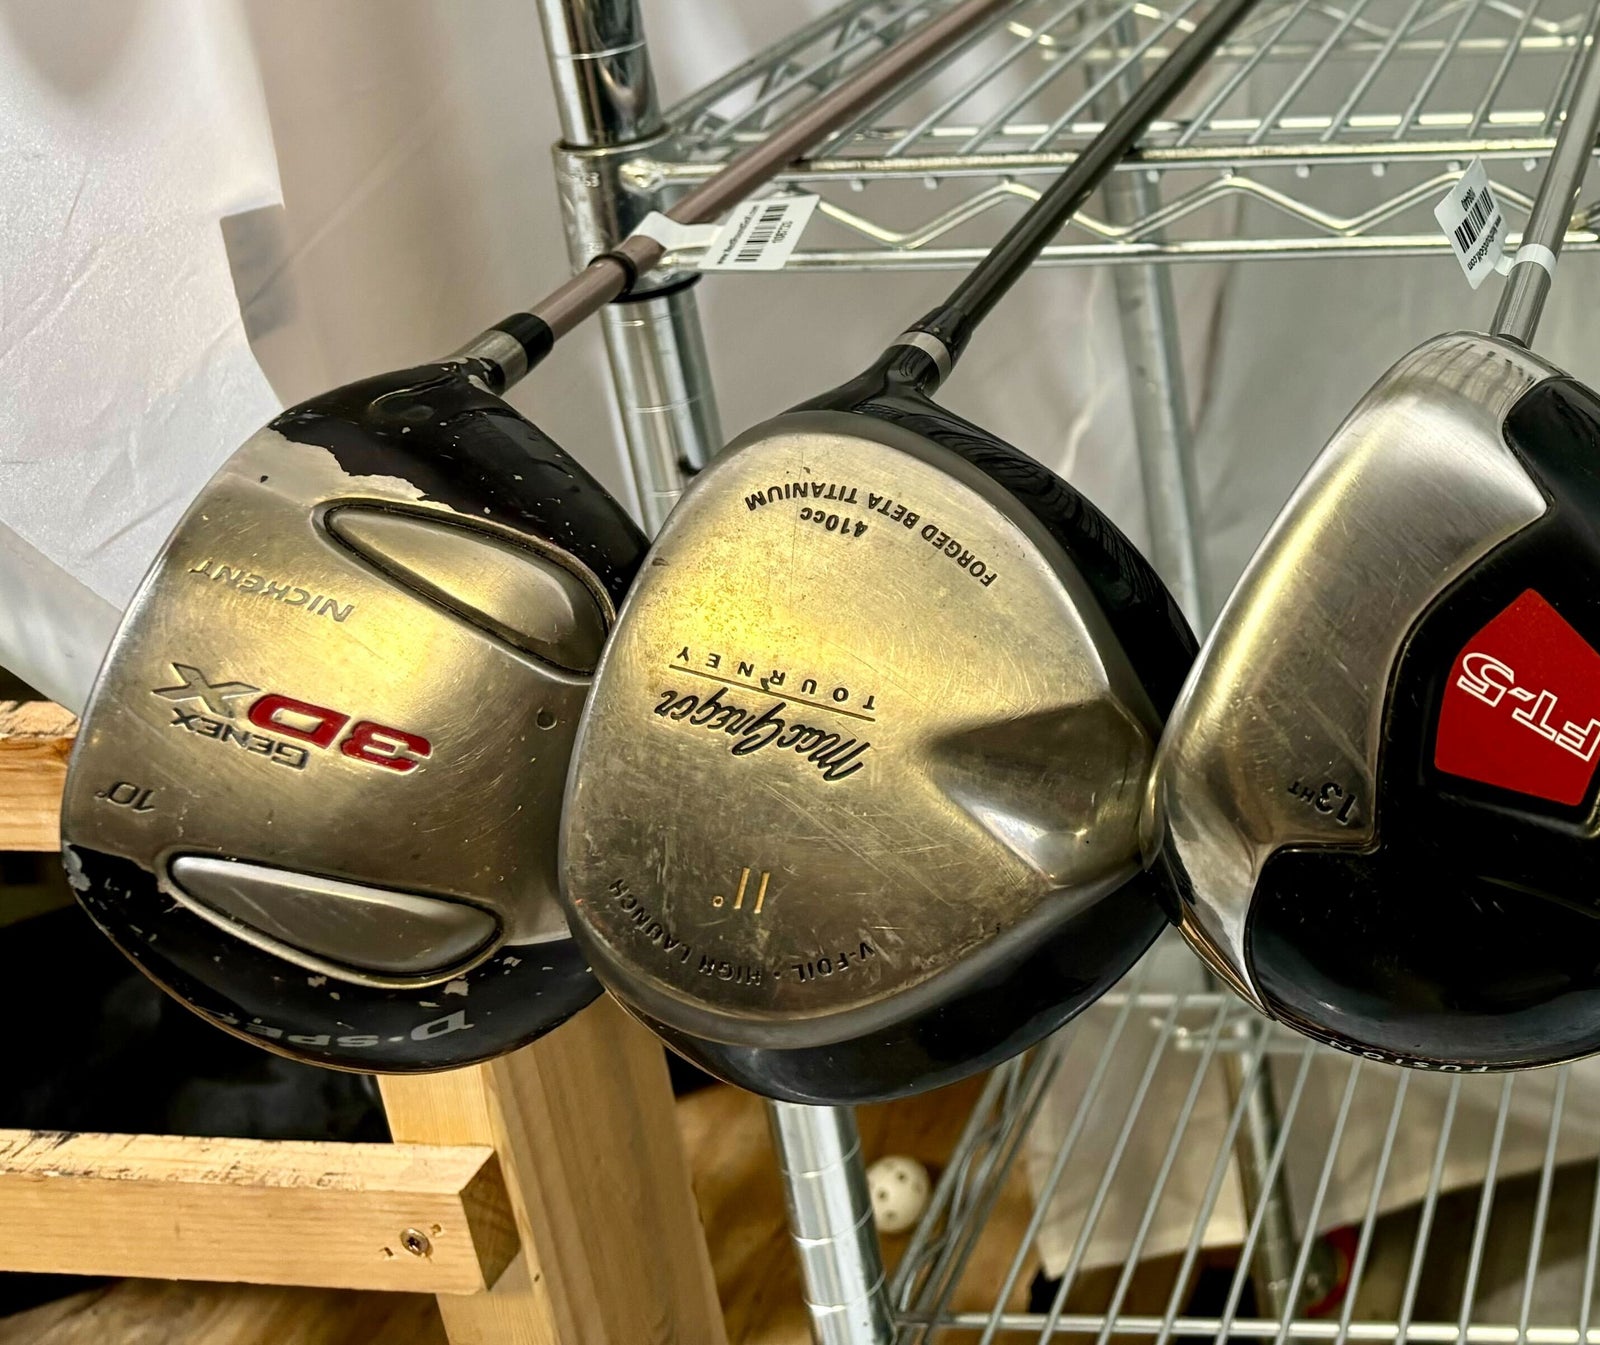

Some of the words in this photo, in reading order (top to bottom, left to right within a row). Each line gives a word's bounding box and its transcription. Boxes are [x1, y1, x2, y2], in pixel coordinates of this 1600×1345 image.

[744, 481, 858, 511] TITANIUM
[800, 506, 869, 538] 410cc
[868, 492, 921, 530] BETA
[920, 523, 998, 587] FORGED
[188, 557, 355, 623] NICKENT
[676, 646, 876, 711] TOURNEY
[150, 661, 432, 775] 3DX
[169, 706, 310, 771] GENEX
[653, 686, 871, 782] MacGregor
[607, 877, 692, 964] LAUNCH
[699, 954, 762, 986] HIGH
[791, 941, 875, 983] V-FOIL
[1329, 1039, 1489, 1073] FUSION
